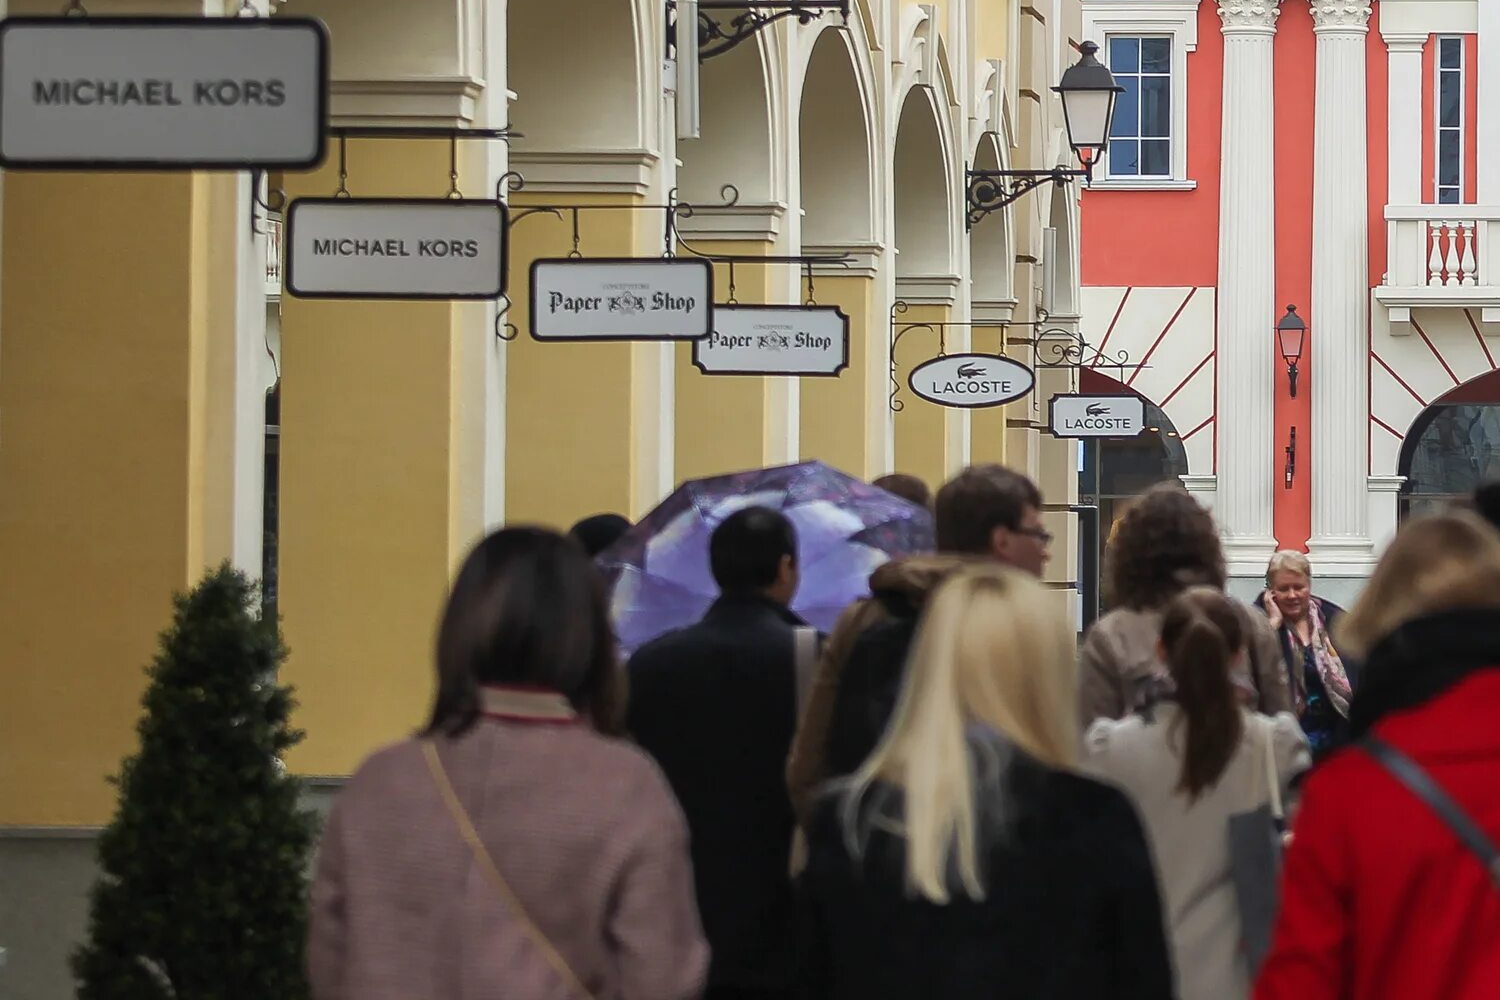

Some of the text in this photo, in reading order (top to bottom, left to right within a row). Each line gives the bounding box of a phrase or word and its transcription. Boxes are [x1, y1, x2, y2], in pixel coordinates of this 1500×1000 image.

[33, 79, 285, 107] MICHAEL KORS
[313, 239, 478, 257] MICHAEL KORS
[549, 291, 695, 314] Paper Shop
[708, 331, 831, 351] Paper Shop
[933, 381, 1012, 394] LACOSTE
[1065, 418, 1131, 430] LACOSTE
